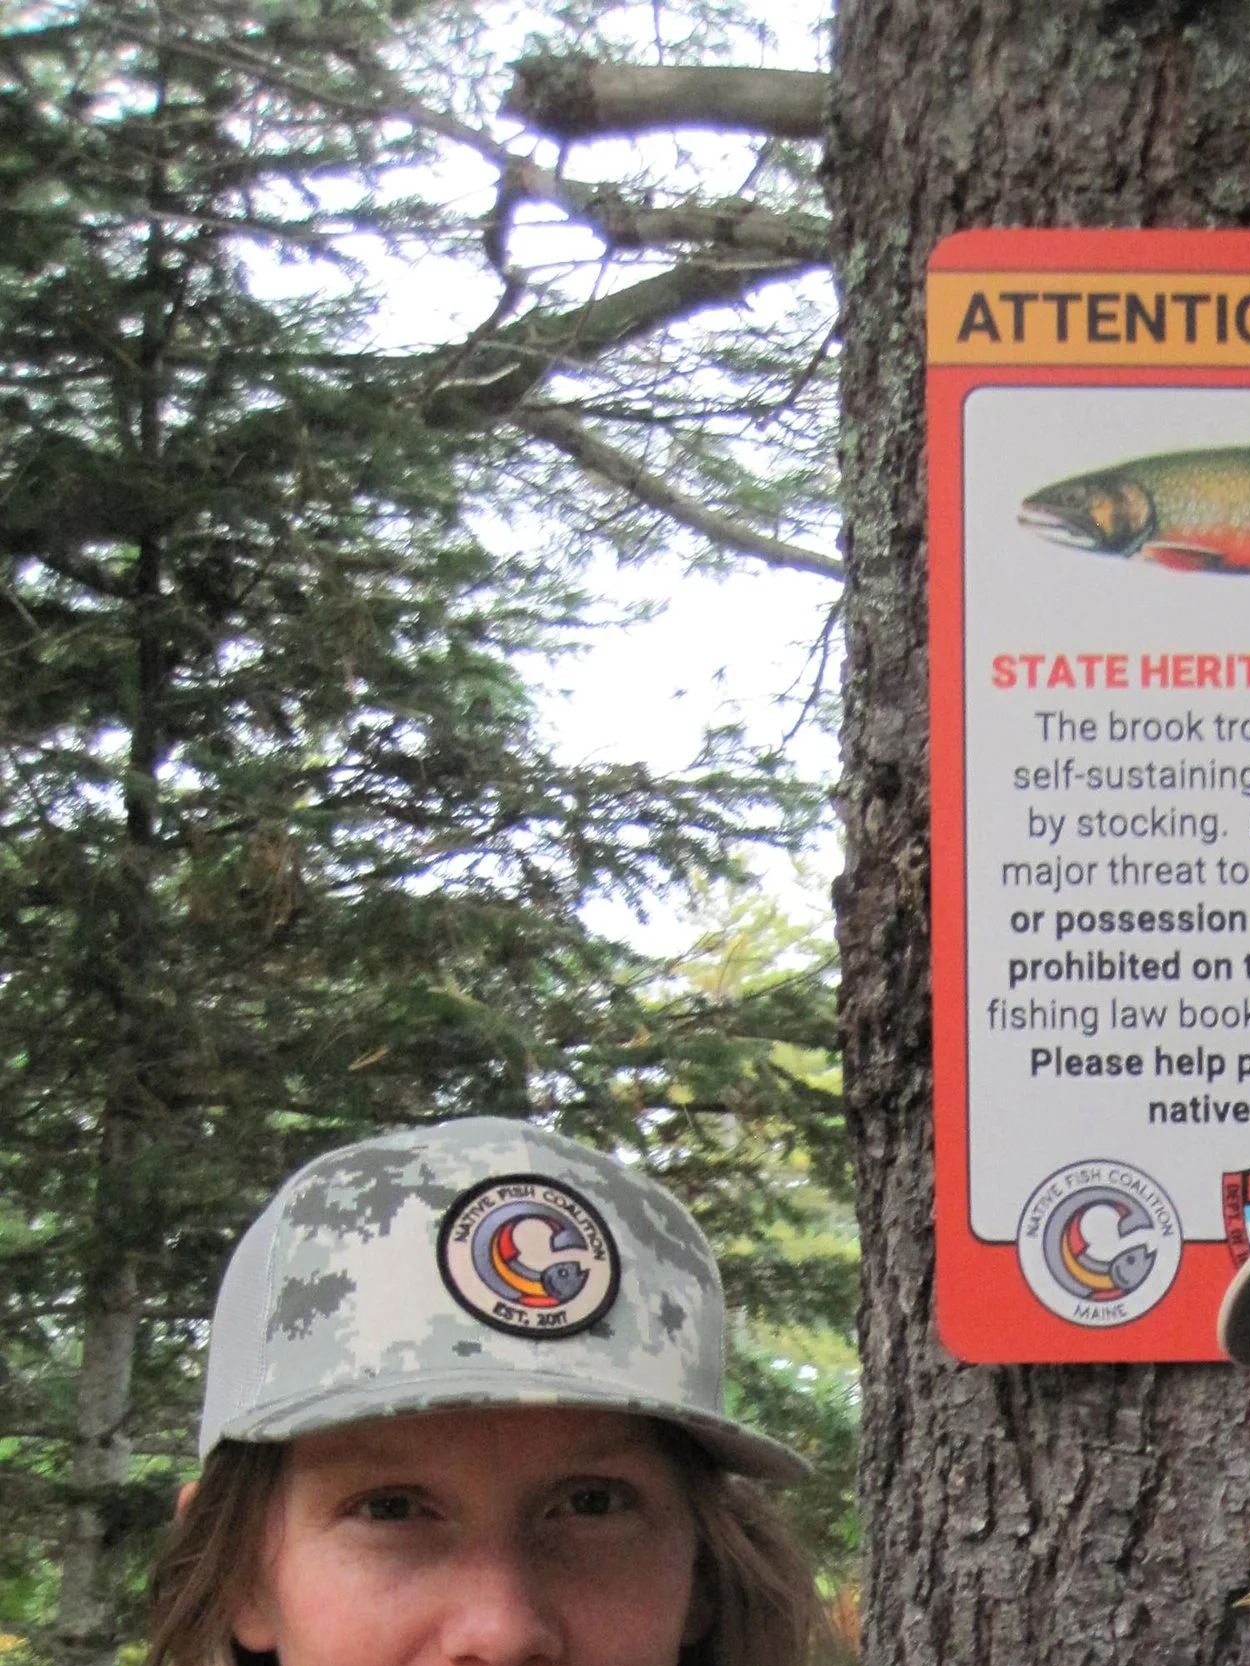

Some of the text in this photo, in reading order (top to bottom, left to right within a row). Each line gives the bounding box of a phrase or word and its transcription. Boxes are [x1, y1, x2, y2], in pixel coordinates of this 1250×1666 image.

[991, 654, 1129, 690] STATE
[1035, 711, 1097, 743] The
[1109, 711, 1205, 743] brook
[1028, 805, 1067, 847] by
[1077, 805, 1229, 846] stocking.
[1001, 854, 1099, 893] major
[1107, 853, 1207, 886] threat
[1215, 856, 1250, 886] to
[1009, 910, 1046, 935] or
[1055, 901, 1248, 942] possession
[1008, 949, 1181, 989] prohibited
[1191, 956, 1233, 981] on
[986, 997, 1099, 1038] fishing
[1111, 997, 1169, 1030] law
[1030, 1046, 1145, 1078] Please
[1154, 1045, 1227, 1084] help
[1026, 1169, 1177, 1238] NATIVE FISH COALITION
[454, 1186, 607, 1262] NATIVE FISH COALITION
[492, 1301, 531, 1326] EST.
[1073, 1304, 1128, 1321] MAINE
